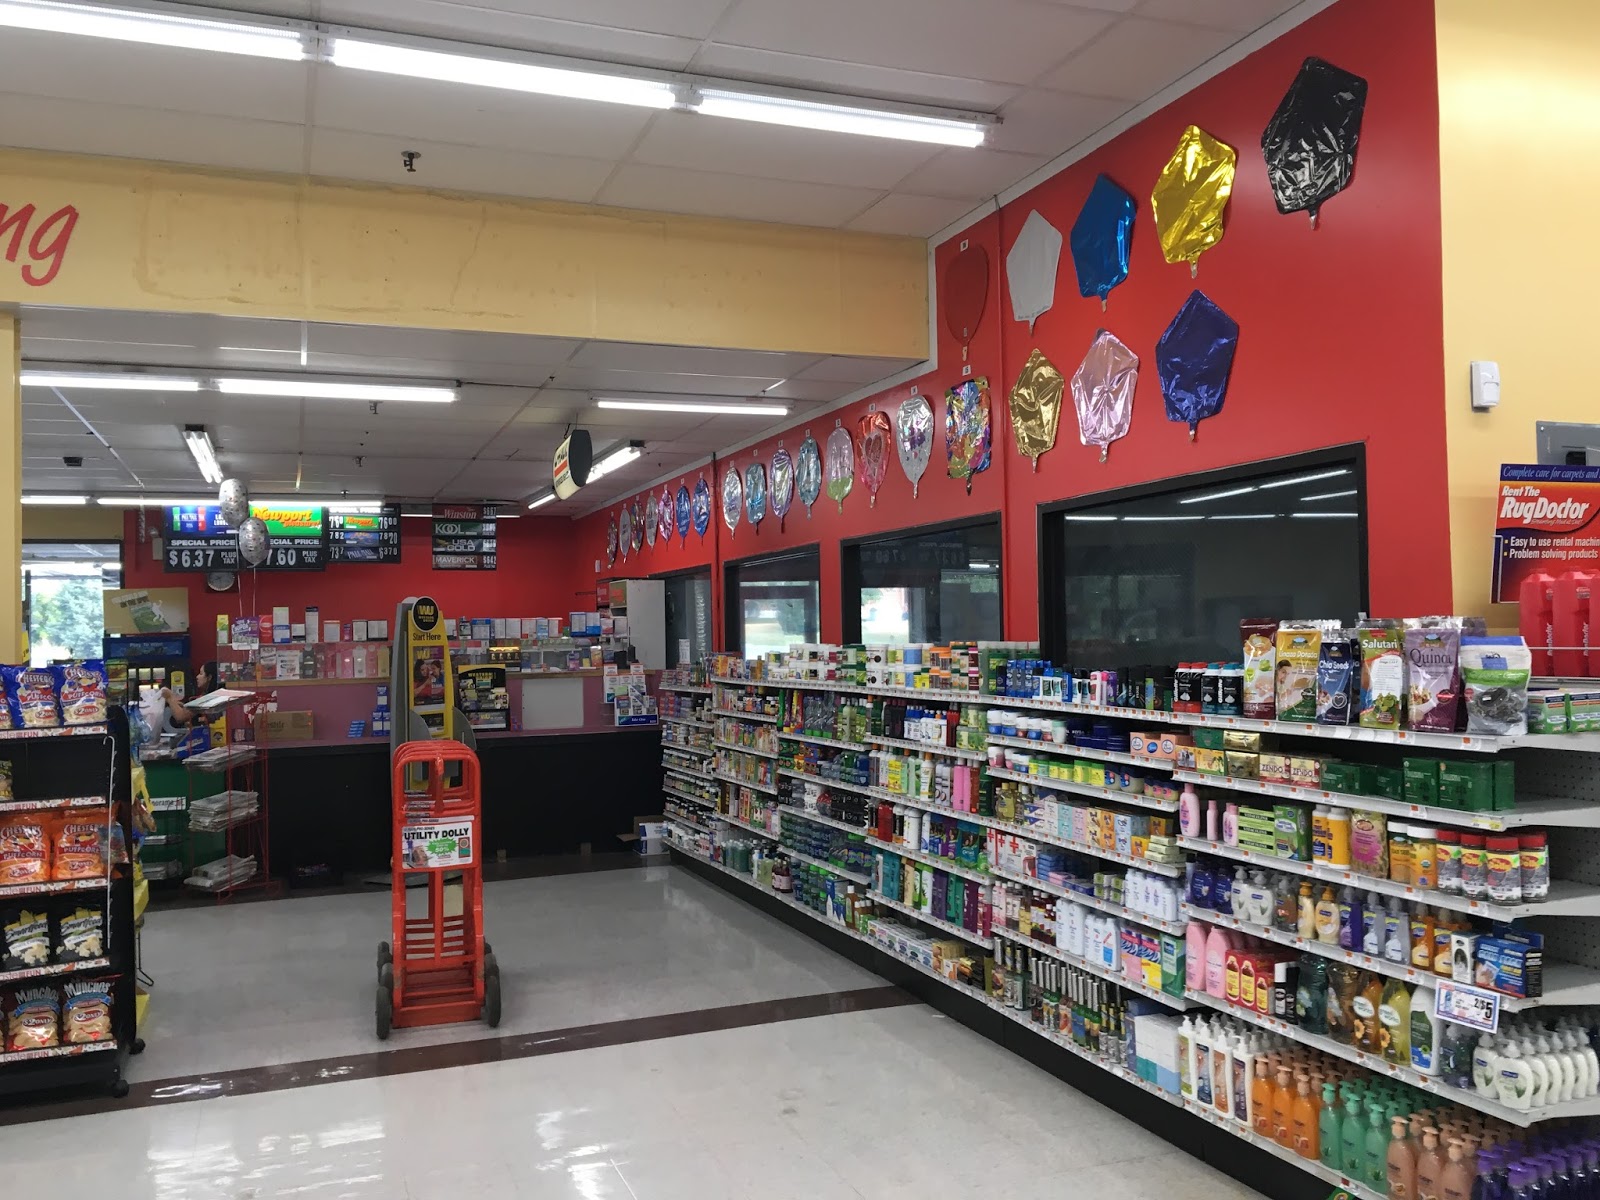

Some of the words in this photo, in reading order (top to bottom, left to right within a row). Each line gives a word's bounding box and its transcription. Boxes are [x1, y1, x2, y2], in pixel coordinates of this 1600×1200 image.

[1503, 466, 1535, 480] Complete
[1549, 467, 1561, 480] for
[1562, 469, 1585, 480] carpets
[1586, 468, 1599, 478] and
[1502, 485, 1524, 497] Rent
[1524, 485, 1540, 497] The
[252, 507, 312, 522] Newport
[444, 508, 477, 519] Winston
[435, 523, 464, 534] KOOL
[1510, 536, 1527, 548] Easy
[1529, 537, 1536, 546] to
[1538, 538, 1551, 547] use
[1553, 537, 1573, 547] rental
[169, 549, 214, 568] $6.37
[266, 548, 296, 566] 7.60
[435, 556, 475, 564] MAVERICK
[1509, 549, 1539, 559] Problem
[1541, 549, 1566, 560] solving
[1568, 549, 1598, 560] products
[413, 632, 425, 640] Start
[426, 632, 441, 640] Here
[1362, 639, 1398, 649] Salutari
[404, 831, 439, 840] UTILITY
[442, 828, 469, 838] DOLLY
